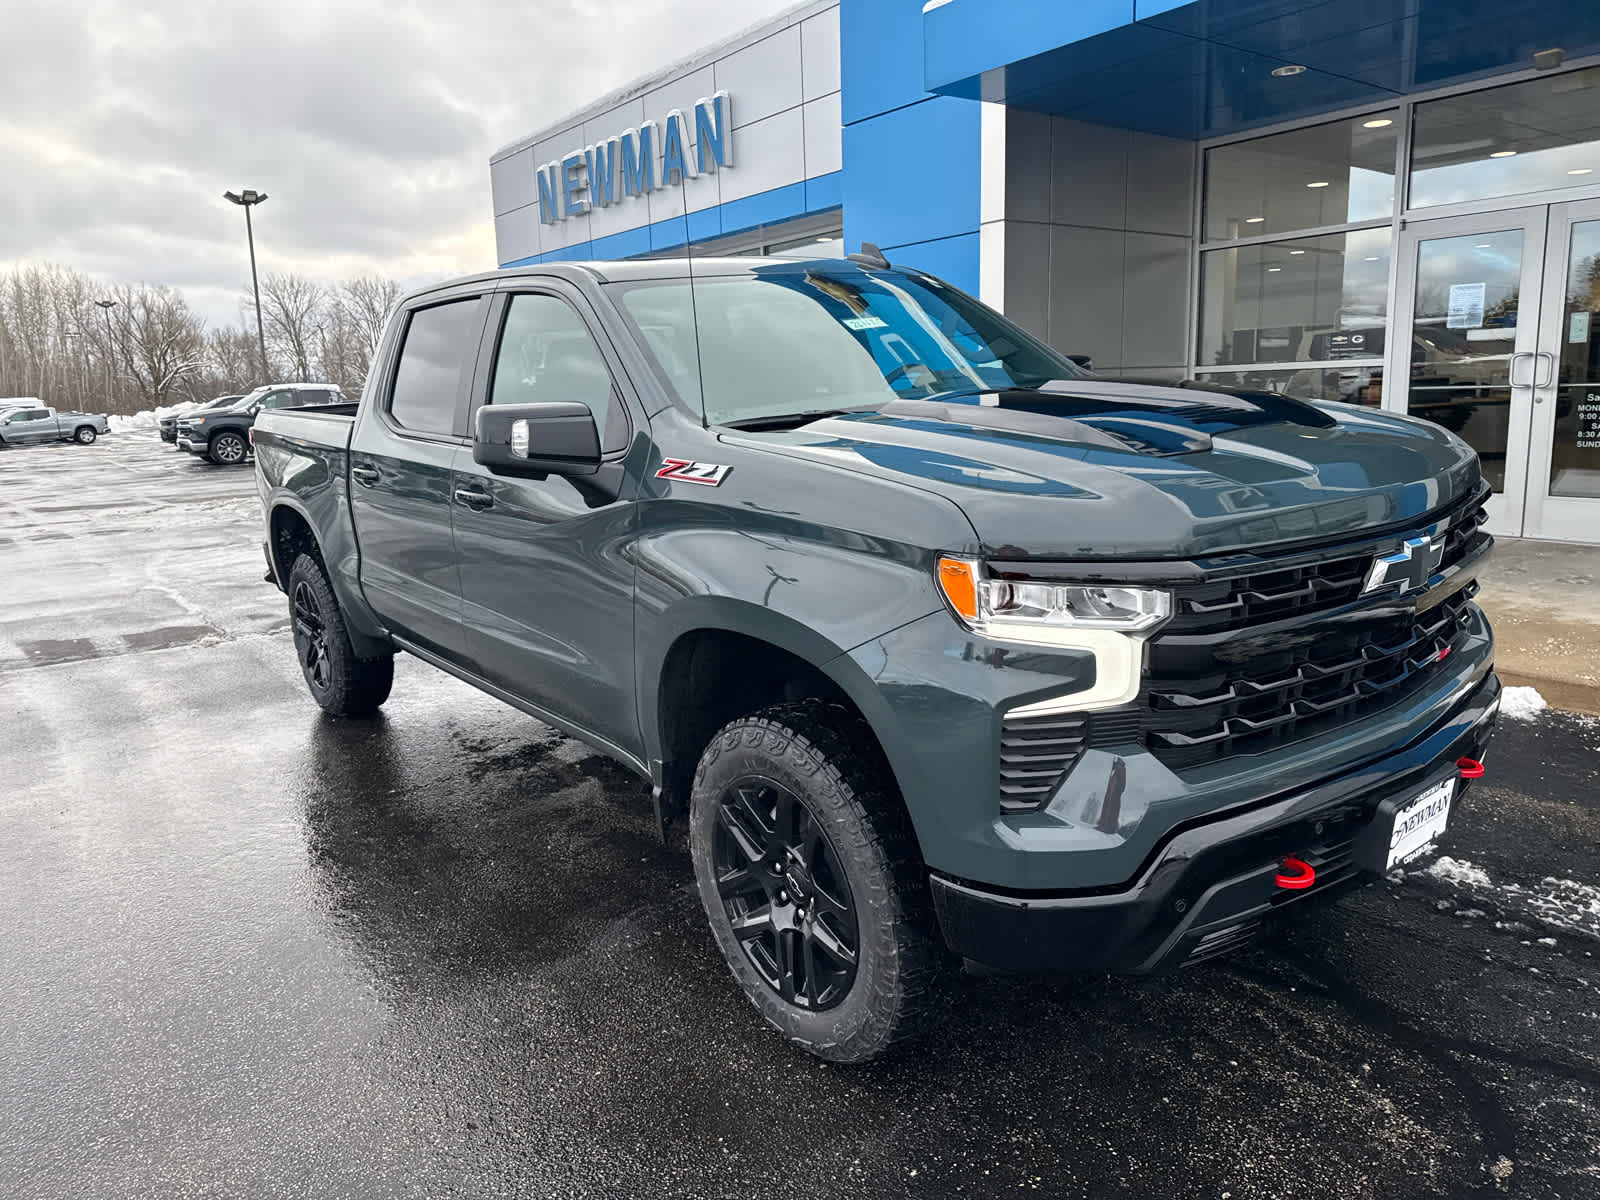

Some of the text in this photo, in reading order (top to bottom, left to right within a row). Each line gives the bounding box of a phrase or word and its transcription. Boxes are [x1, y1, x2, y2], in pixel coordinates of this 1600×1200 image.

[537, 91, 733, 225] NEWMAN
[1577, 430, 1595, 438] 8:30
[1392, 792, 1450, 845] NEWMAN
